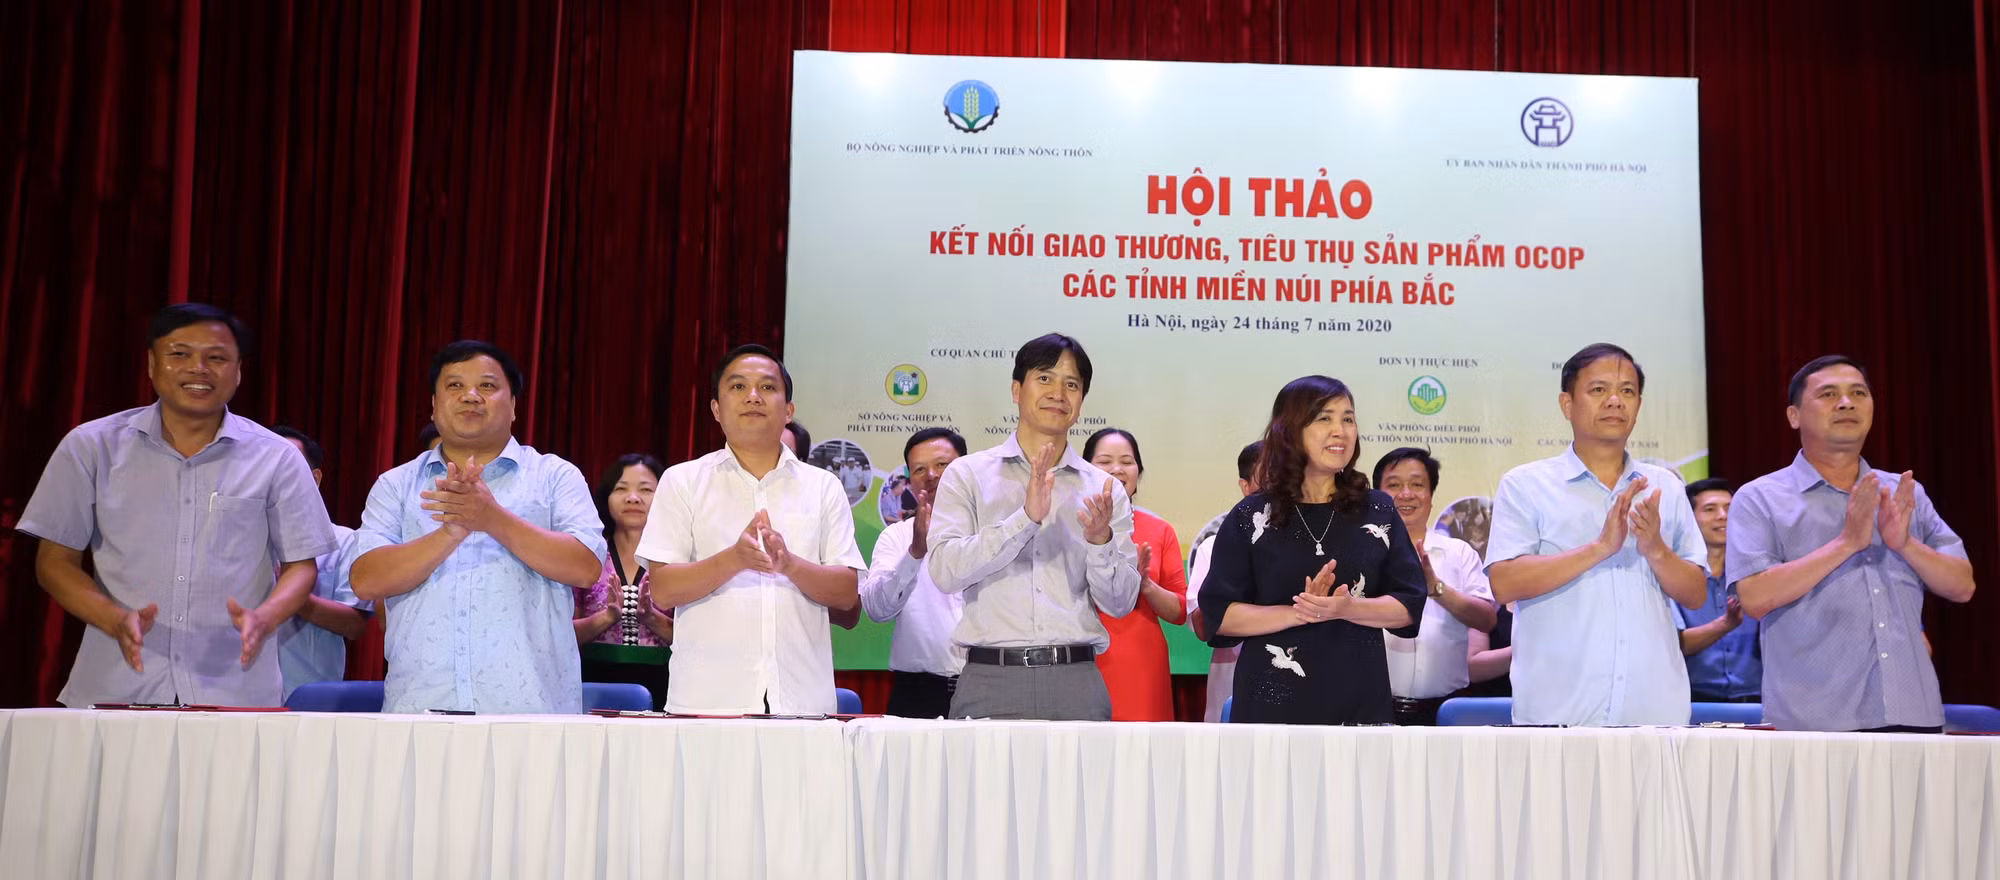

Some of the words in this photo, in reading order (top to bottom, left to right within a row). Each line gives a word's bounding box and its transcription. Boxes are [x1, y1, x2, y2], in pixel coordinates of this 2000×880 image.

[864, 142, 896, 153] NÔNG
[899, 143, 940, 155] NGHIỆP
[943, 144, 957, 154] VÀ
[961, 144, 988, 155] PHÁT
[1028, 145, 1059, 156] NÔNG
[1062, 146, 1092, 157] THÔN
[1464, 159, 1485, 168] BAN
[1147, 167, 1231, 227] HỘI
[1248, 167, 1373, 220] THẢO
[929, 223, 979, 255] KẾT
[987, 224, 1034, 257] NỐI
[1044, 233, 1106, 258] GIAO
[1115, 233, 1229, 264] THƯƠNG,
[1239, 233, 1296, 263] TIÊU
[1305, 240, 1355, 269] THỤ
[1364, 233, 1418, 265] SẢN
[1428, 234, 1505, 268] PHẨM
[1515, 245, 1585, 270] OCOP
[1063, 269, 1117, 298] CÁC
[1125, 267, 1187, 299] TỈNH
[1197, 269, 1266, 301] MIỀN
[1275, 273, 1321, 302] NÚI
[1331, 275, 1393, 304] PHÍA
[1402, 273, 1455, 306] BẮC
[1128, 314, 1149, 328] Hà
[1155, 315, 1186, 331] Nội,
[1191, 315, 1228, 332] ngày
[1233, 316, 1250, 329] 24
[1256, 317, 1299, 333] tháng
[1305, 318, 1313, 331] 7
[1318, 319, 1351, 332] năm
[1356, 319, 1392, 332] 2020
[930, 348, 947, 358] CƠ
[949, 349, 980, 359] QUAN
[983, 348, 1006, 358] CHỦ
[873, 412, 899, 421] NÔNG
[901, 413, 937, 423] NGHIỆP
[940, 413, 952, 422] VÀ
[847, 423, 872, 432] PHÁT
[984, 425, 1011, 435] NÔNG
